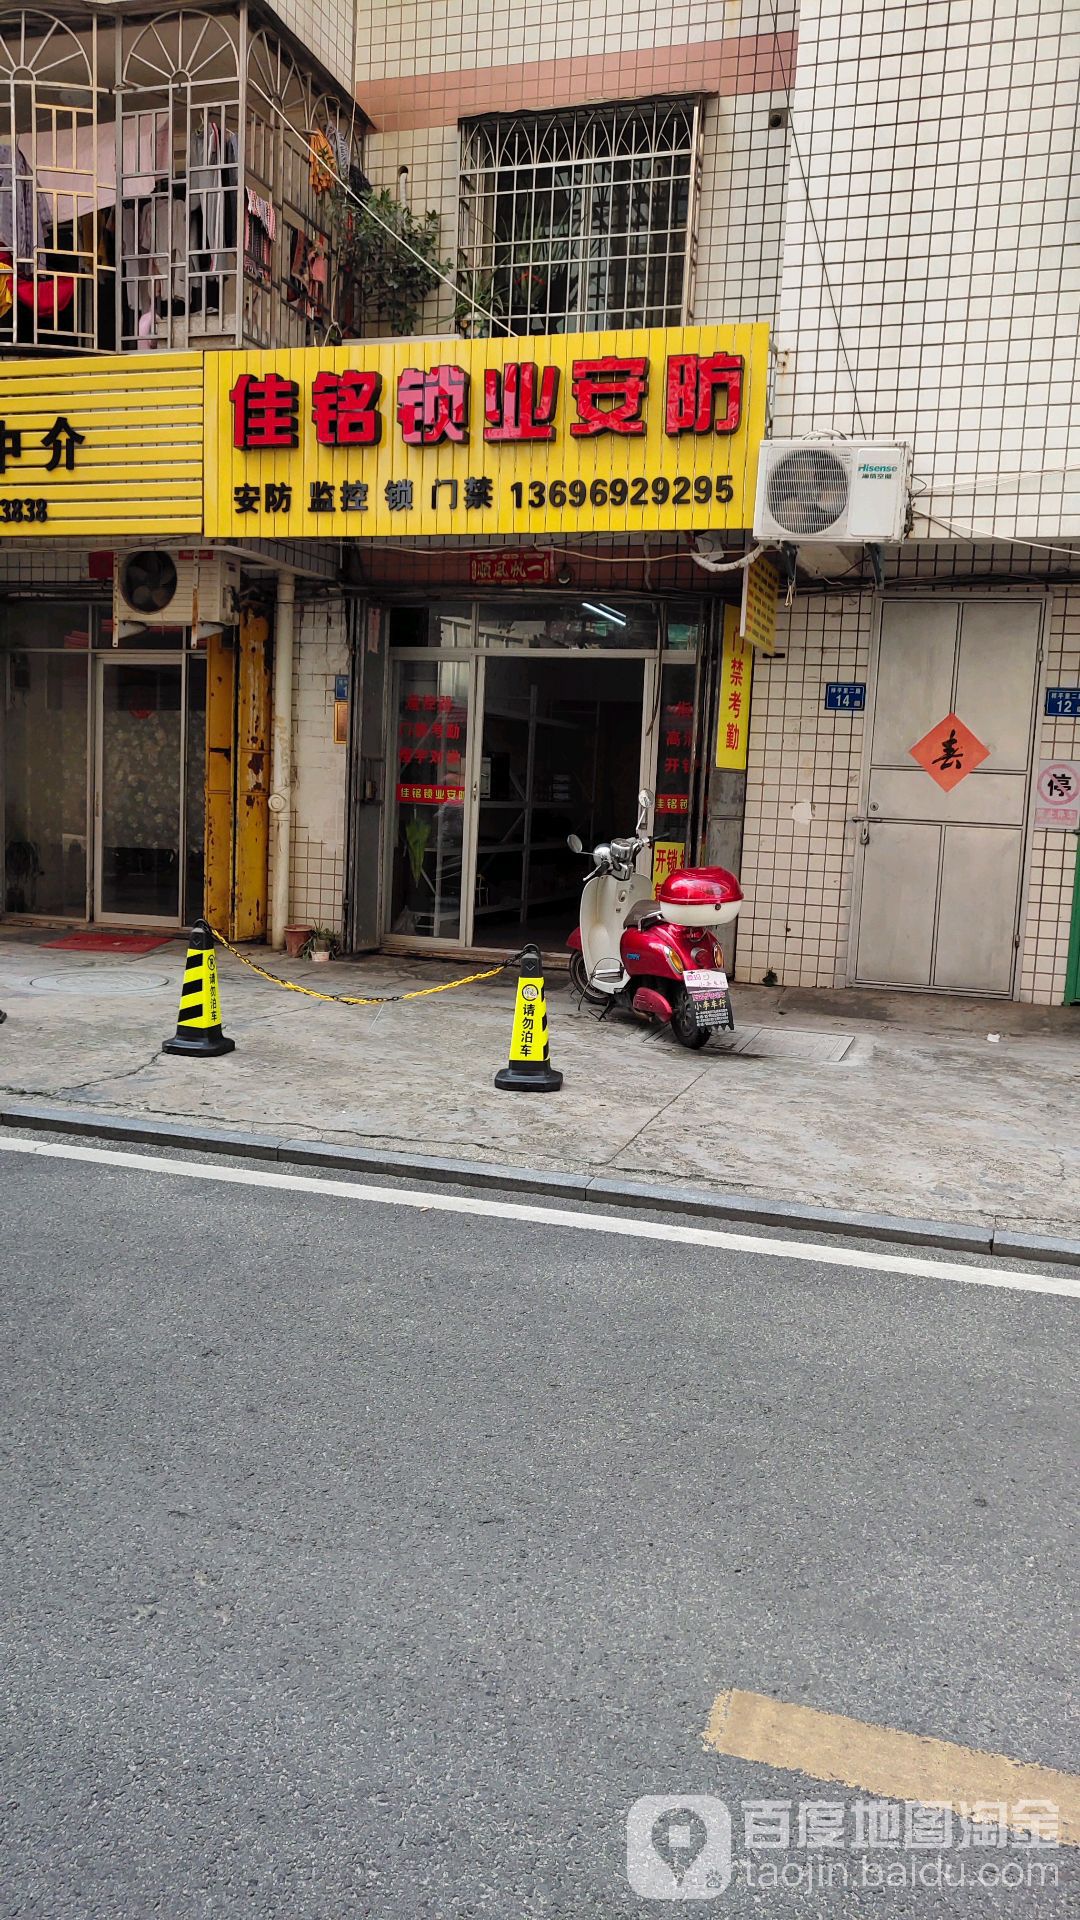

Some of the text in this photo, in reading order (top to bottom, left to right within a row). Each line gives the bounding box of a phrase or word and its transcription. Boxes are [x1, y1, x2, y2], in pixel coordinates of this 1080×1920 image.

[230, 351, 744, 451] 佳铭锁业安防
[858, 463, 898, 472] Hisense
[233, 475, 734, 514] 安防 监控 锁 门禁 13696929295
[725, 624, 746, 751] 门禁考勤
[1047, 773, 1072, 797] 停
[208, 973, 218, 1022] 请勿泊车
[519, 1003, 536, 1057] 请勿泊车
